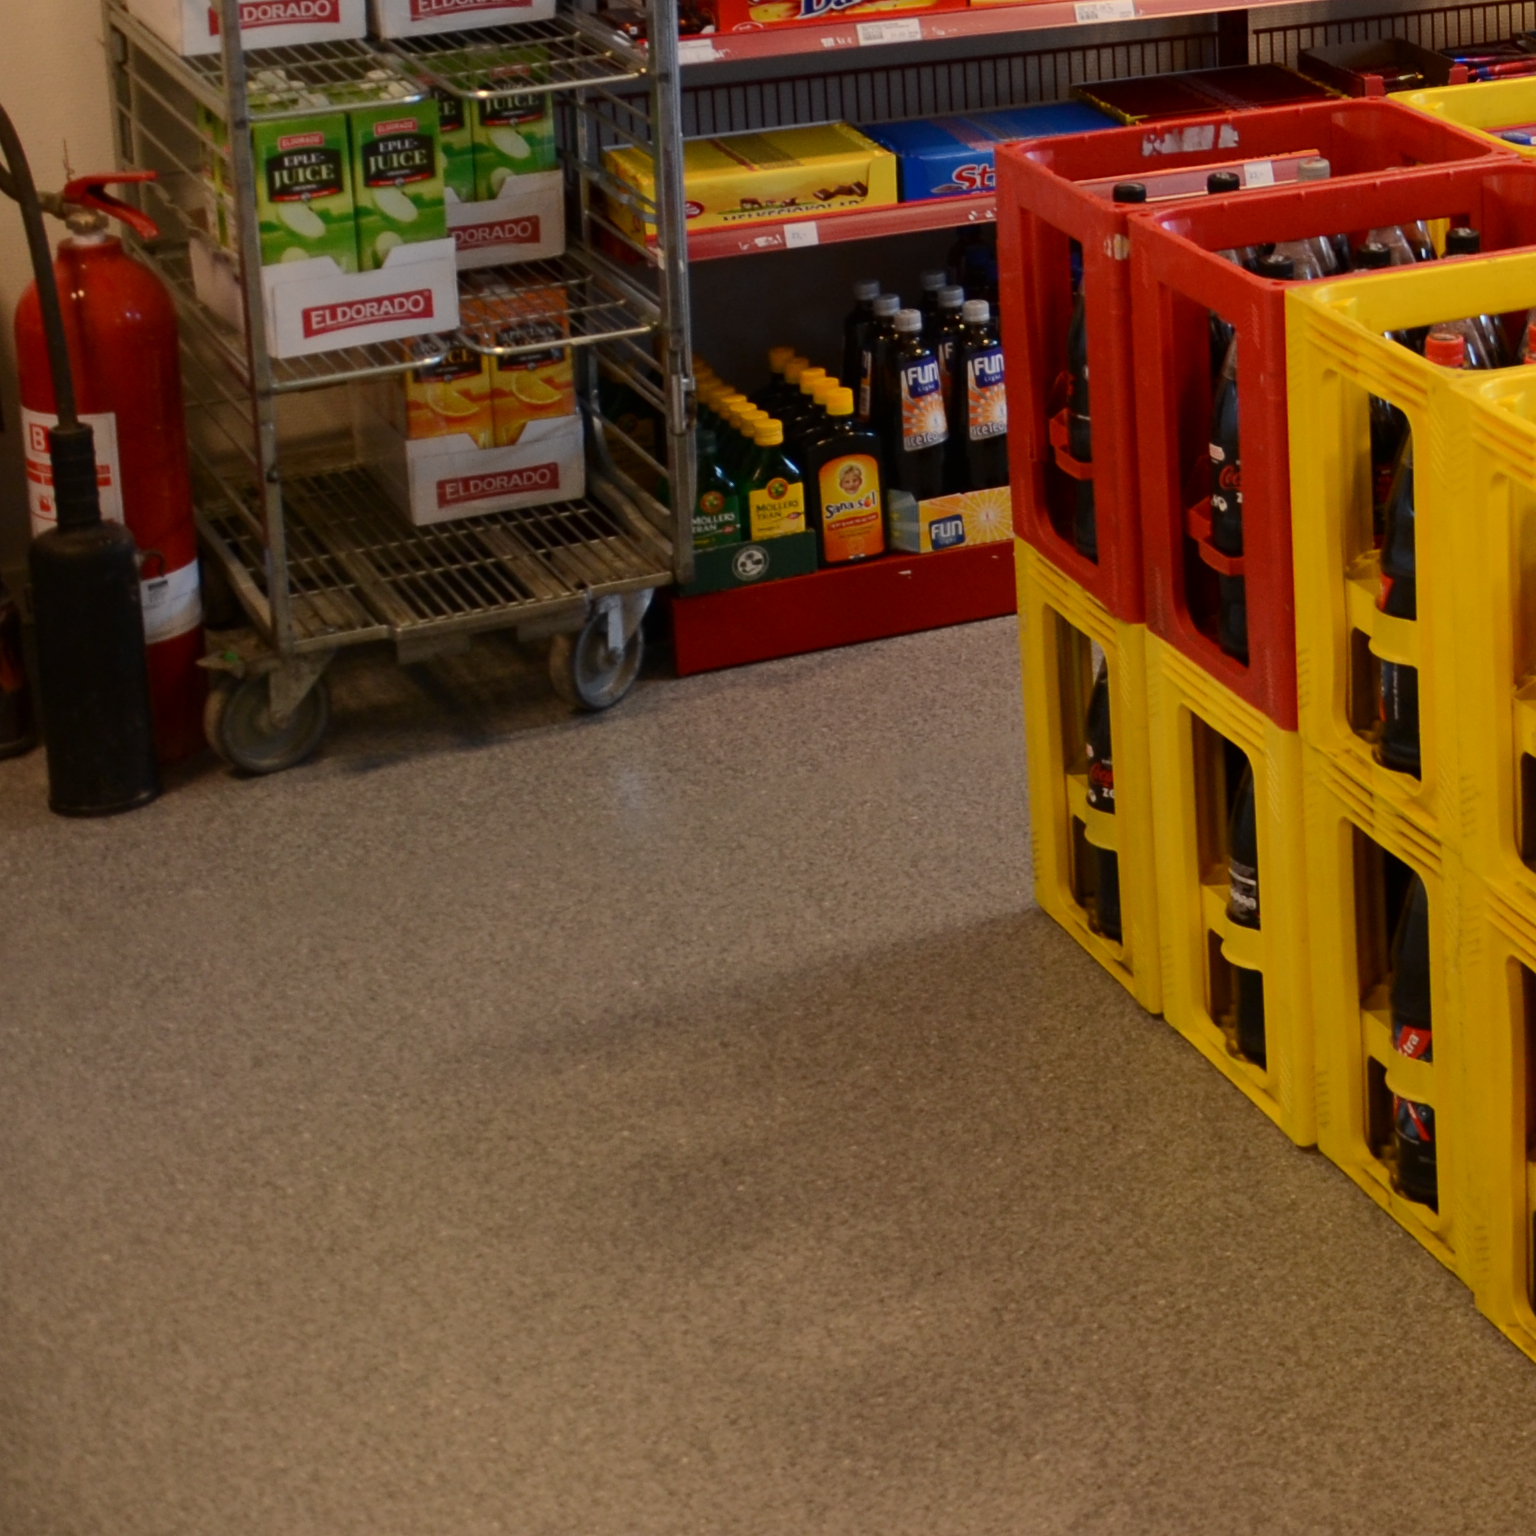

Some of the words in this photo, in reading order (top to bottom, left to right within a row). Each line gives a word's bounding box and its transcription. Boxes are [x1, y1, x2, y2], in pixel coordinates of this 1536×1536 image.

[240, 0, 332, 23] DORADO
[378, 138, 418, 152] EPLE-
[284, 153, 325, 166] EPLE-
[368, 149, 428, 175] JUICE
[273, 164, 335, 190] JUICE
[452, 220, 532, 244] DORADO
[311, 295, 425, 330] ELDORADO
[907, 362, 938, 387] FUN
[974, 353, 1004, 376] FUN
[446, 468, 551, 500] ELDORADO
[756, 511, 782, 520] TRAN
[931, 520, 962, 541] FUN
[1401, 1031, 1420, 1058] tra
